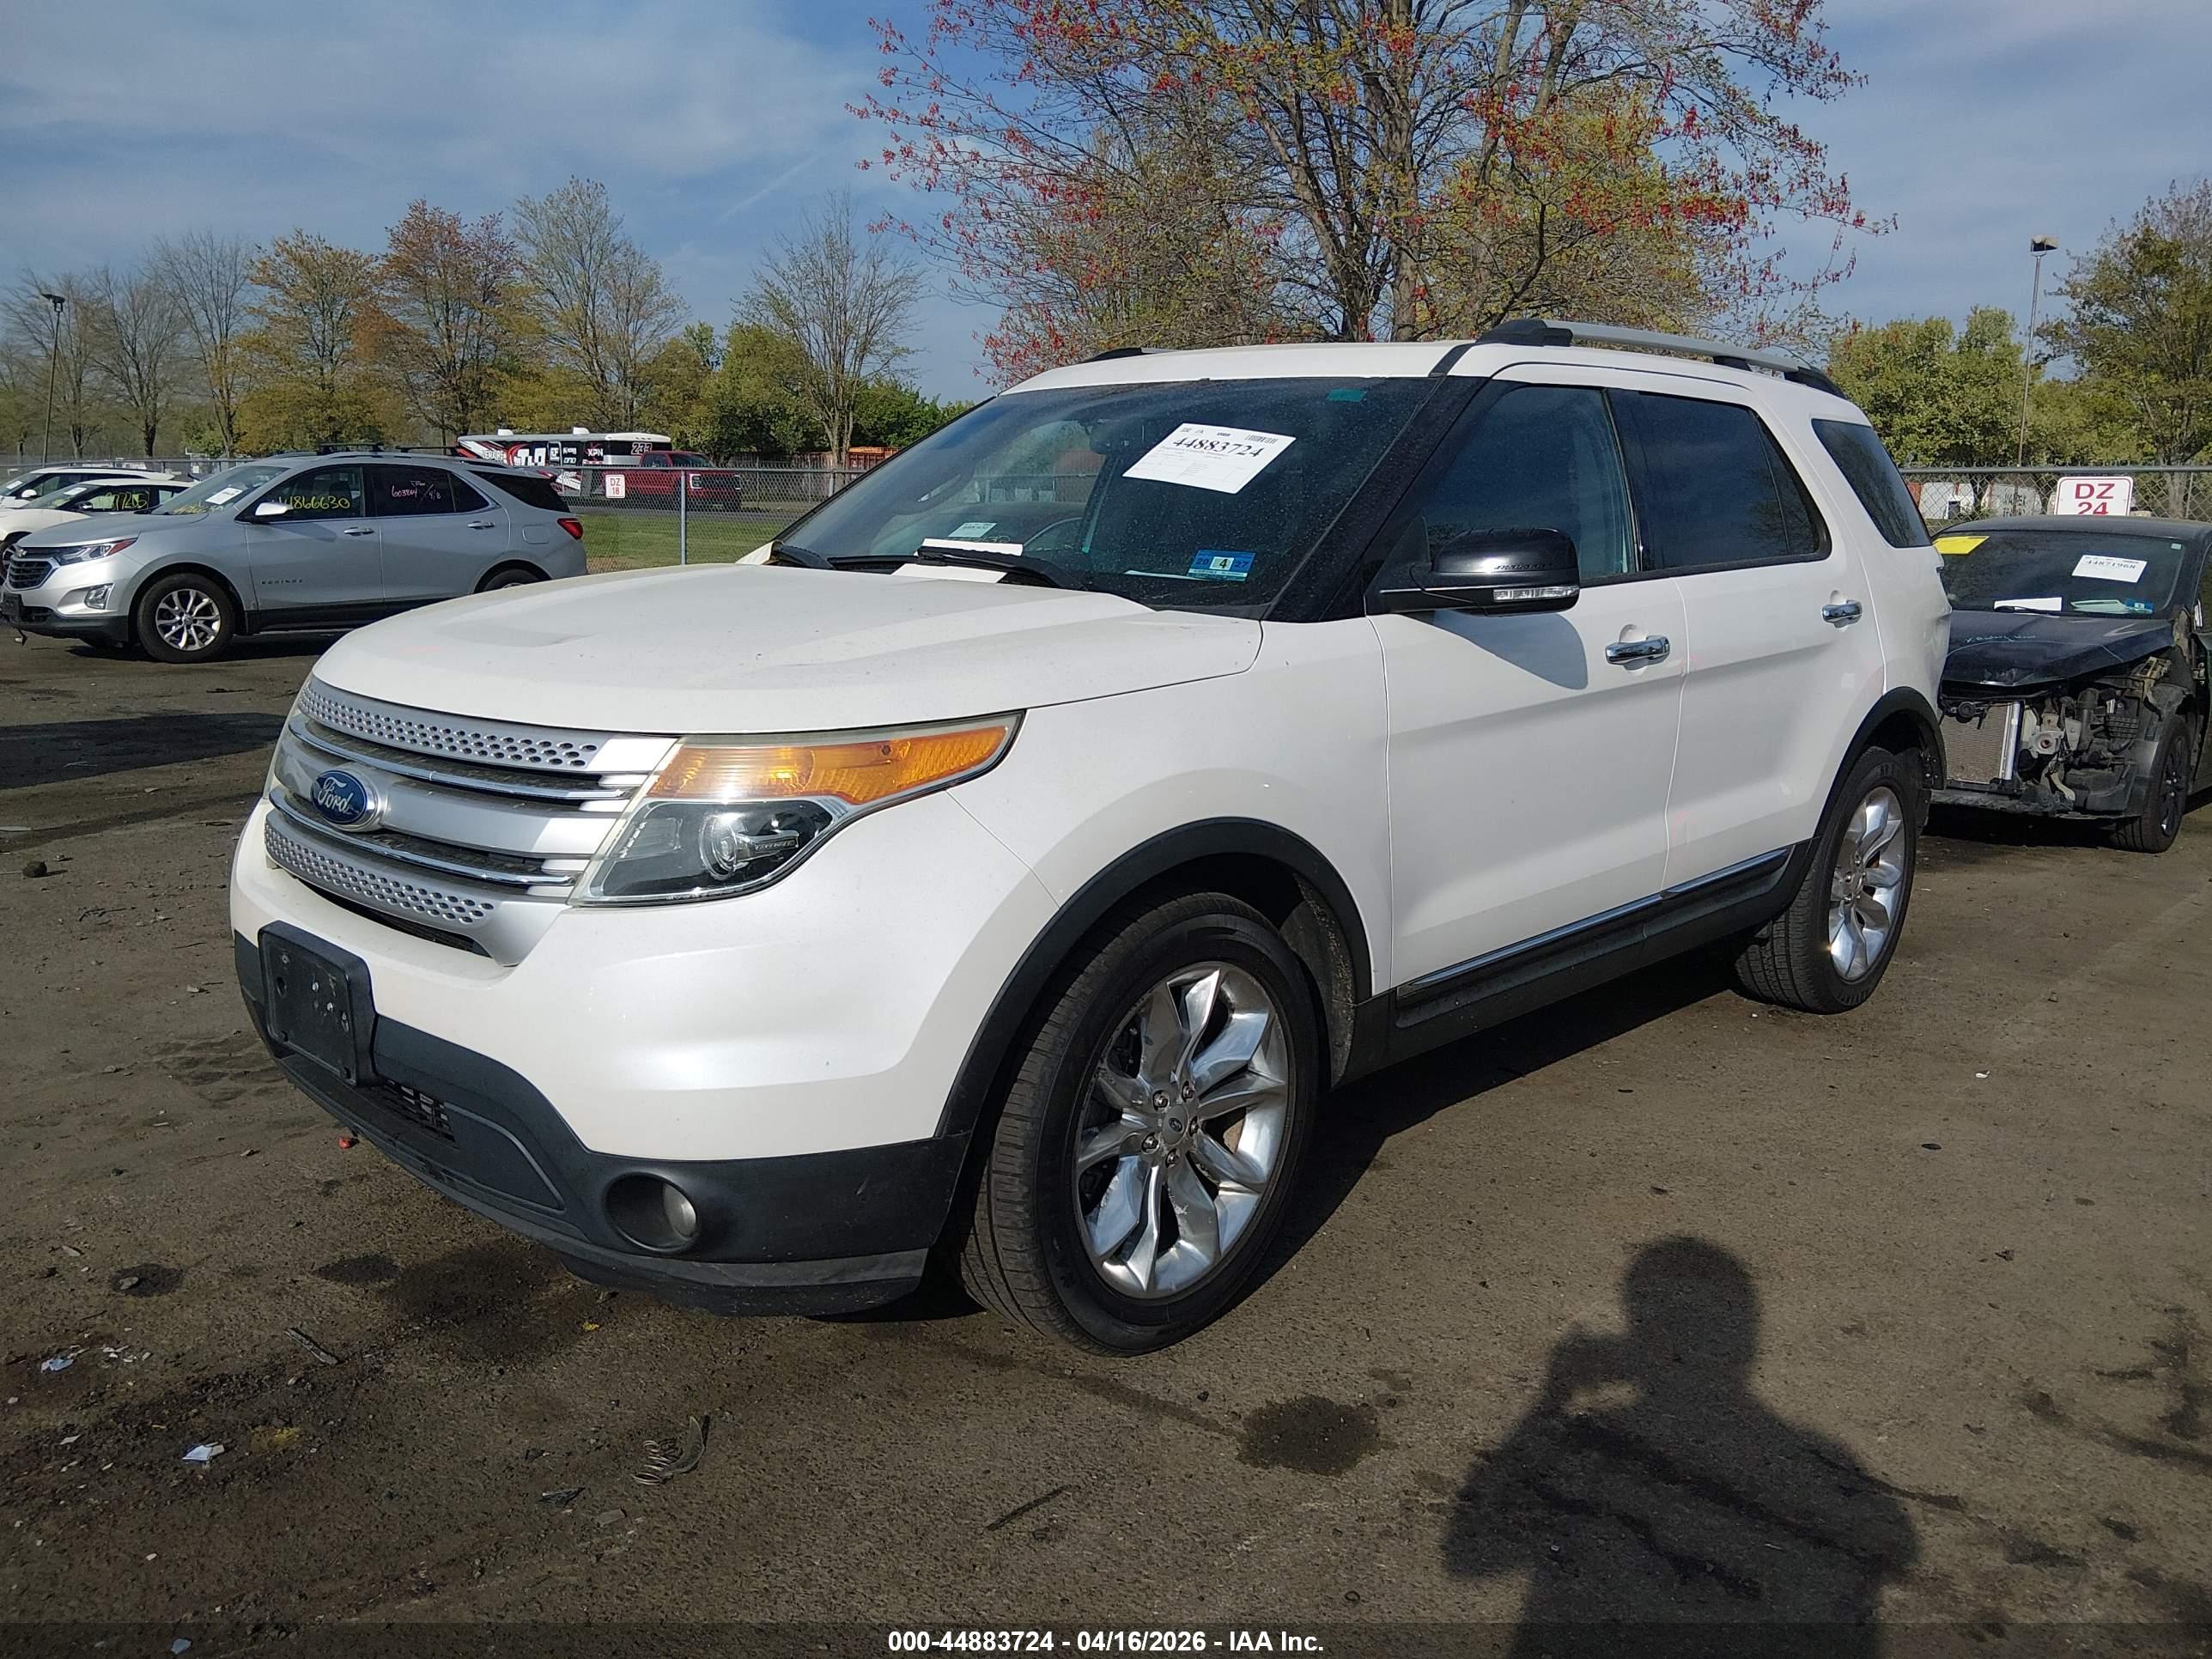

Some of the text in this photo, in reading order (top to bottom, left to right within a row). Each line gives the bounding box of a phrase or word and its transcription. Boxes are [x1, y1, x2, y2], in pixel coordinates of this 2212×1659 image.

[1173, 437, 1265, 458] 44883724
[610, 477, 621, 486] DZ
[2075, 483, 2115, 500] DZ
[2077, 501, 2109, 515] 24
[1219, 558, 1228, 569] 4
[318, 776, 356, 814] Ford
